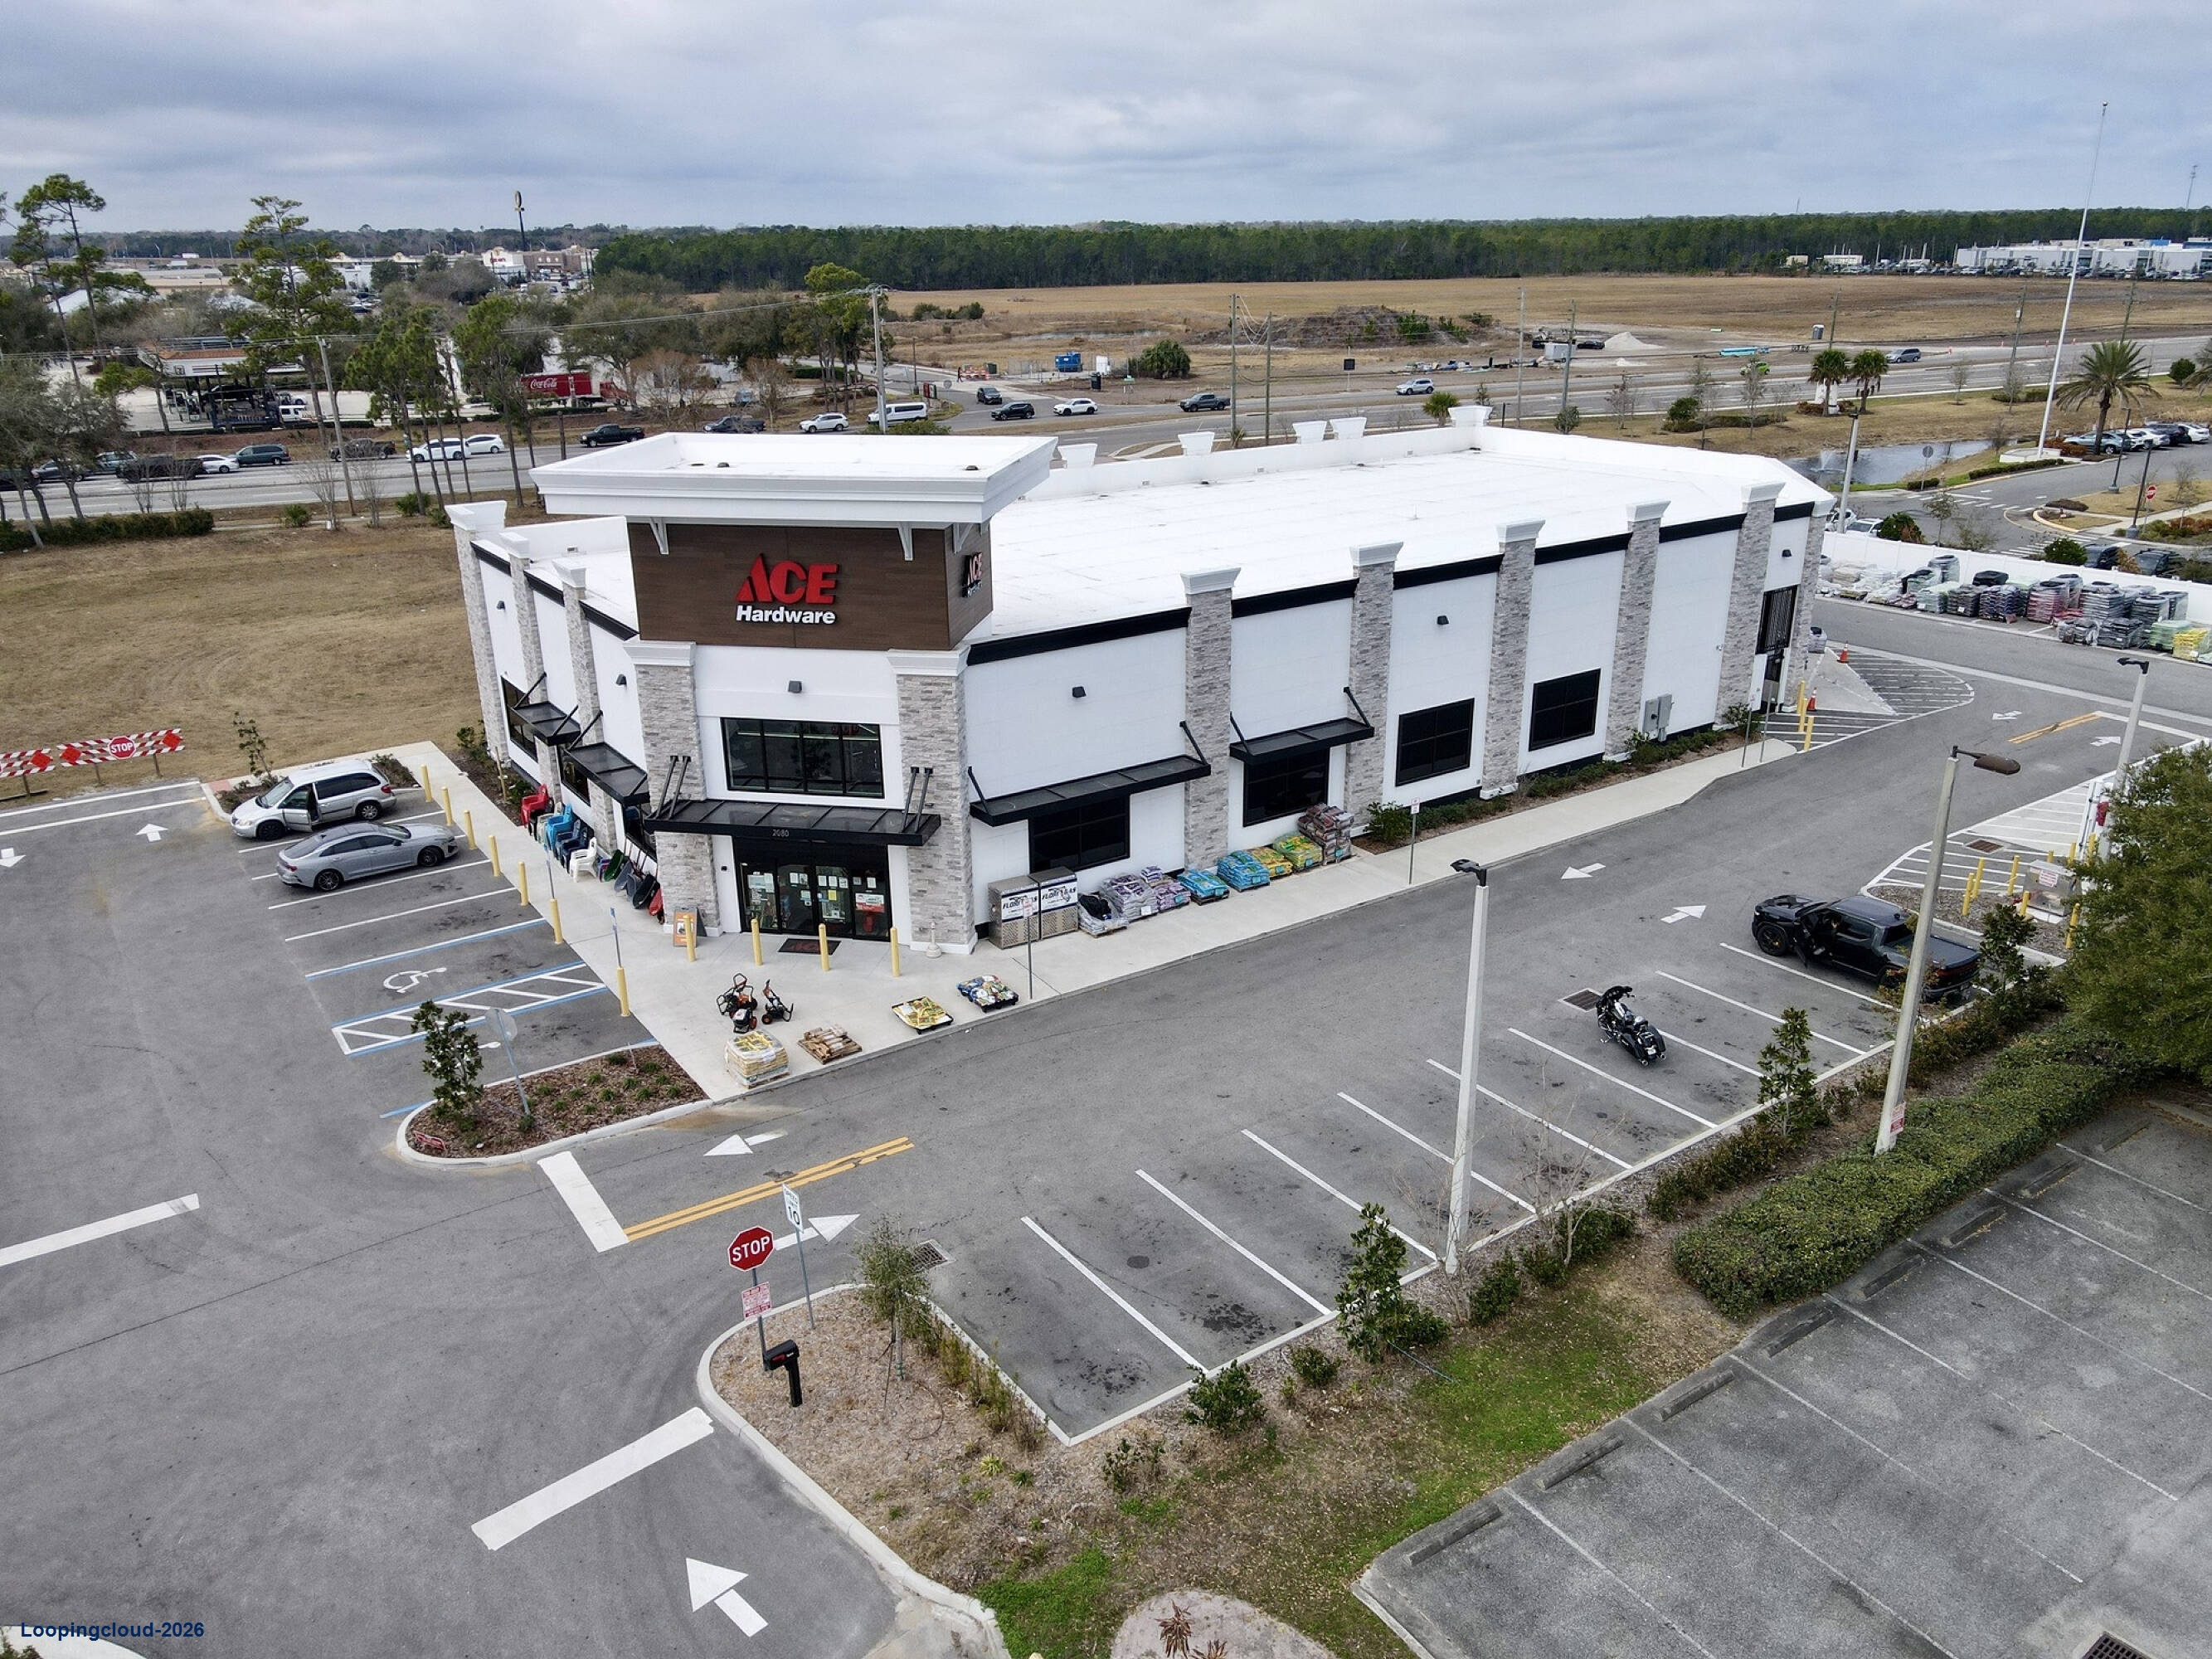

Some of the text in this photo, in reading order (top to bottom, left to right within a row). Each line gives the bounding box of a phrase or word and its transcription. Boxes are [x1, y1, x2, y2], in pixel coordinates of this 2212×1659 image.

[736, 553, 839, 604] ACE
[736, 605, 837, 625] Hardware
[111, 742, 134, 753] STOP
[788, 1206, 800, 1225] 10
[732, 1236, 771, 1262] STOP
